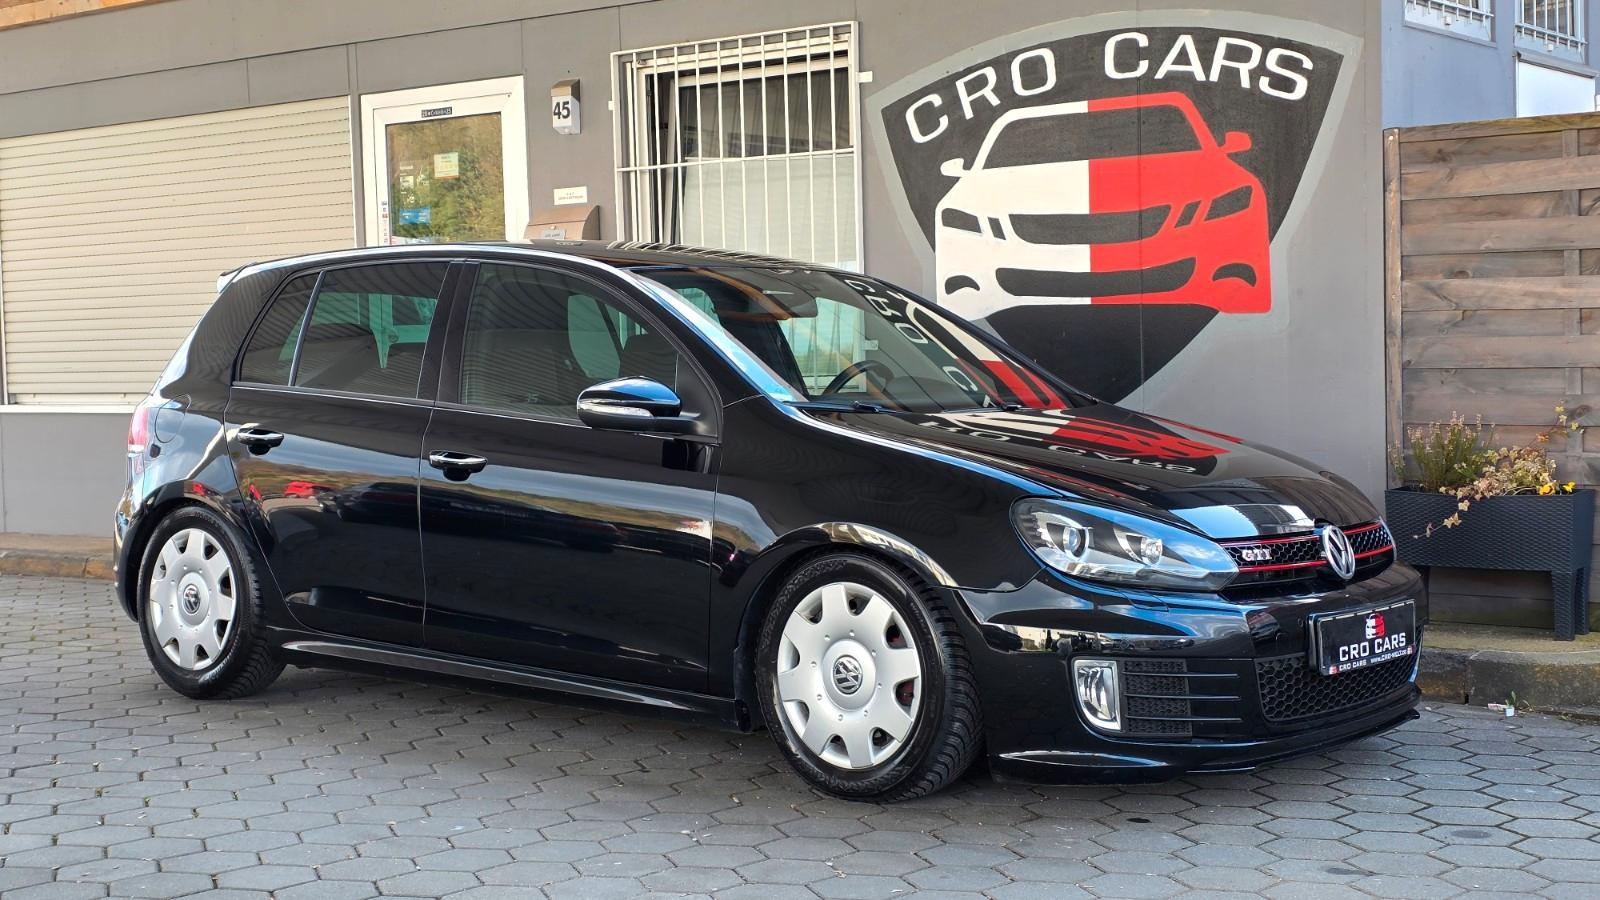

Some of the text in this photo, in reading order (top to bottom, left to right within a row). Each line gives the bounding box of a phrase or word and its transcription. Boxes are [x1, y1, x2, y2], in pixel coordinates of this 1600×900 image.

[905, 31, 1314, 144] CRO CARS
[553, 100, 570, 120] 45
[1242, 548, 1272, 562] GTI
[1339, 632, 1406, 662] CRO CARS
[1339, 663, 1351, 671] CRO
[1352, 659, 1367, 669] CARS
